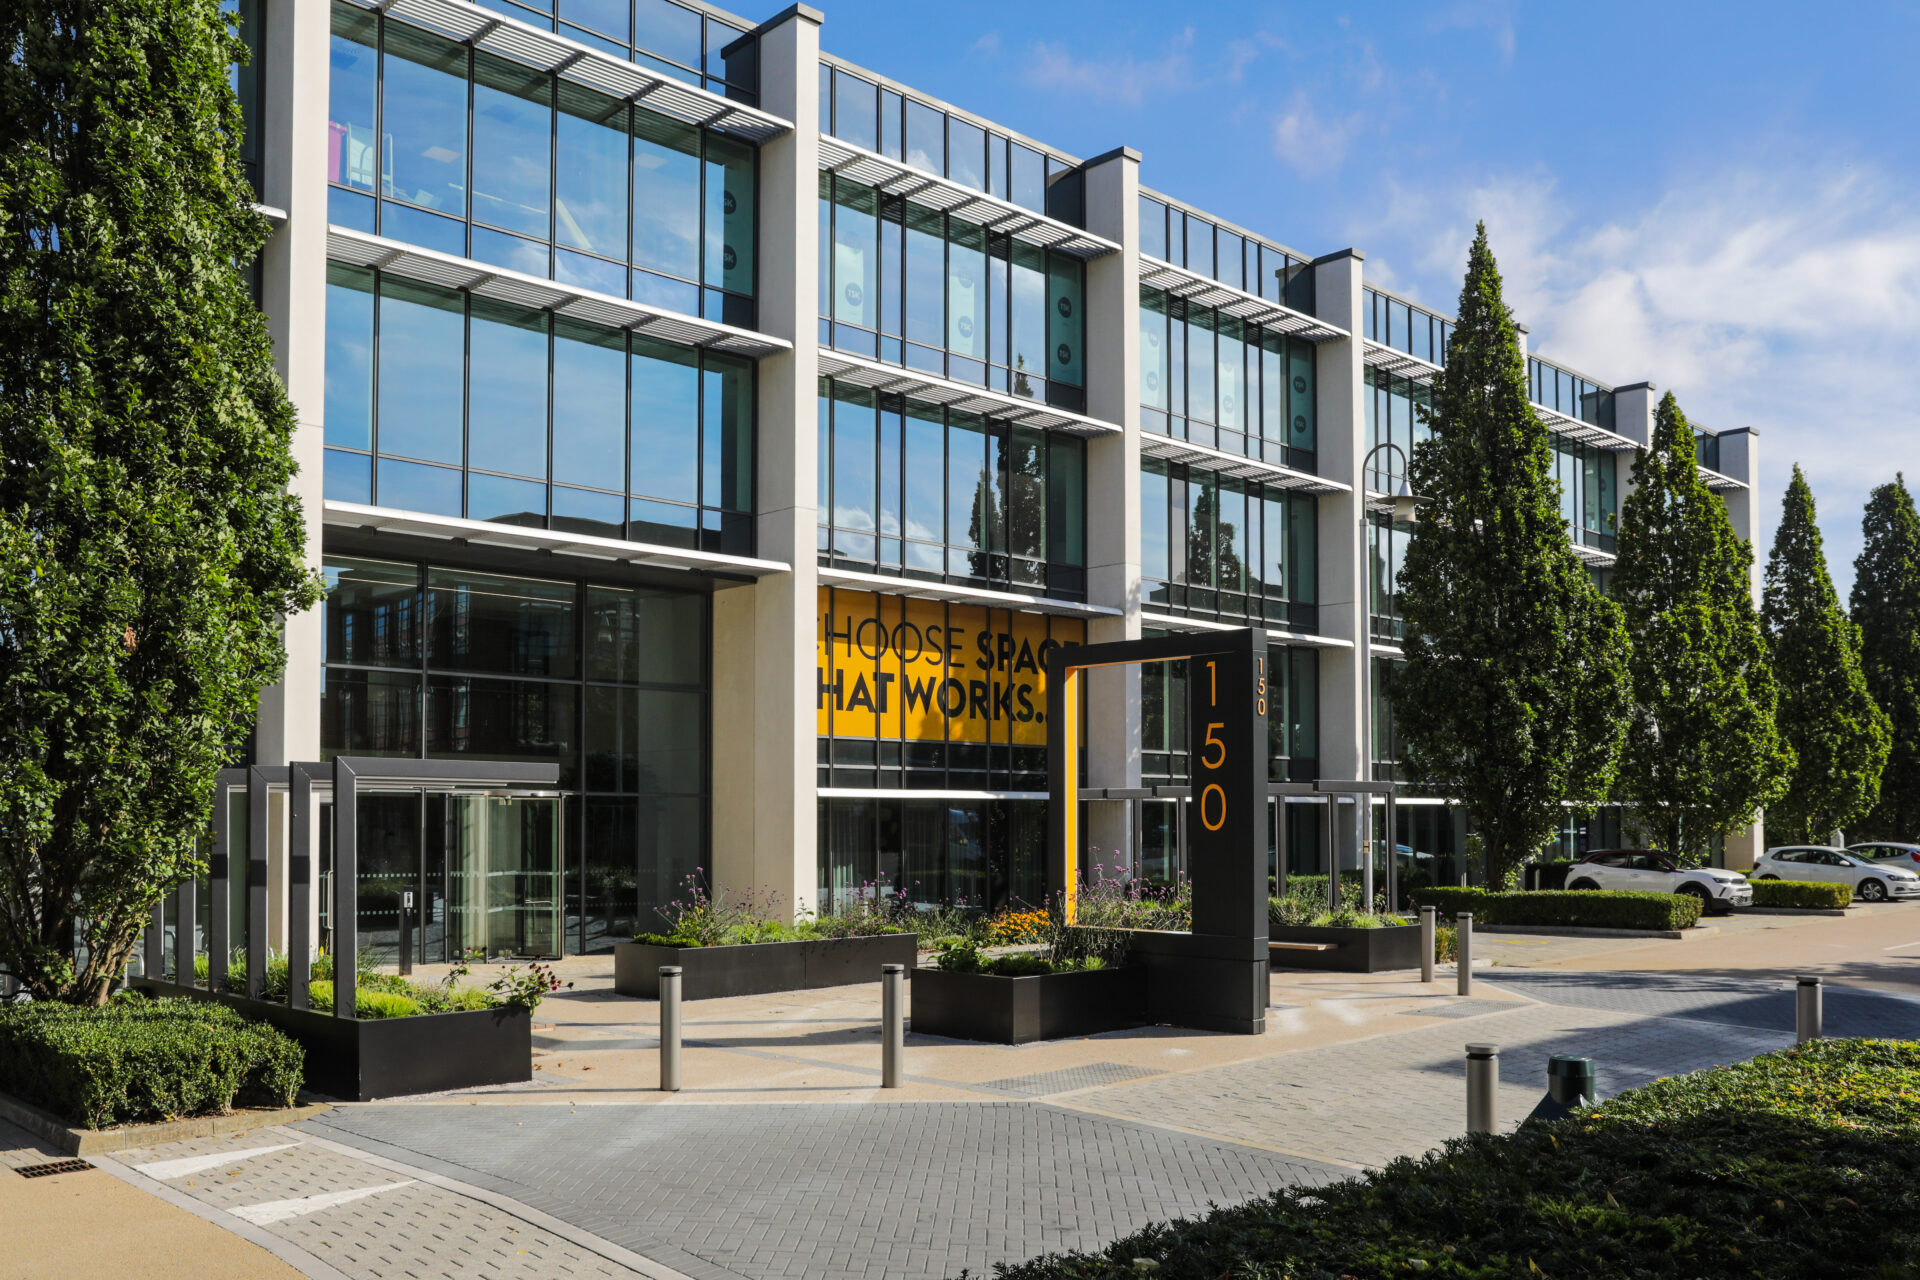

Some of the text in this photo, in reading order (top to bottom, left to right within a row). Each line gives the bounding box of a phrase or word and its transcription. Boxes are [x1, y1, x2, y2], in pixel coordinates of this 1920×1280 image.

[817, 613, 1080, 675] HOOSE SPAC
[1257, 657, 1266, 716] 150
[1201, 660, 1226, 831] 150
